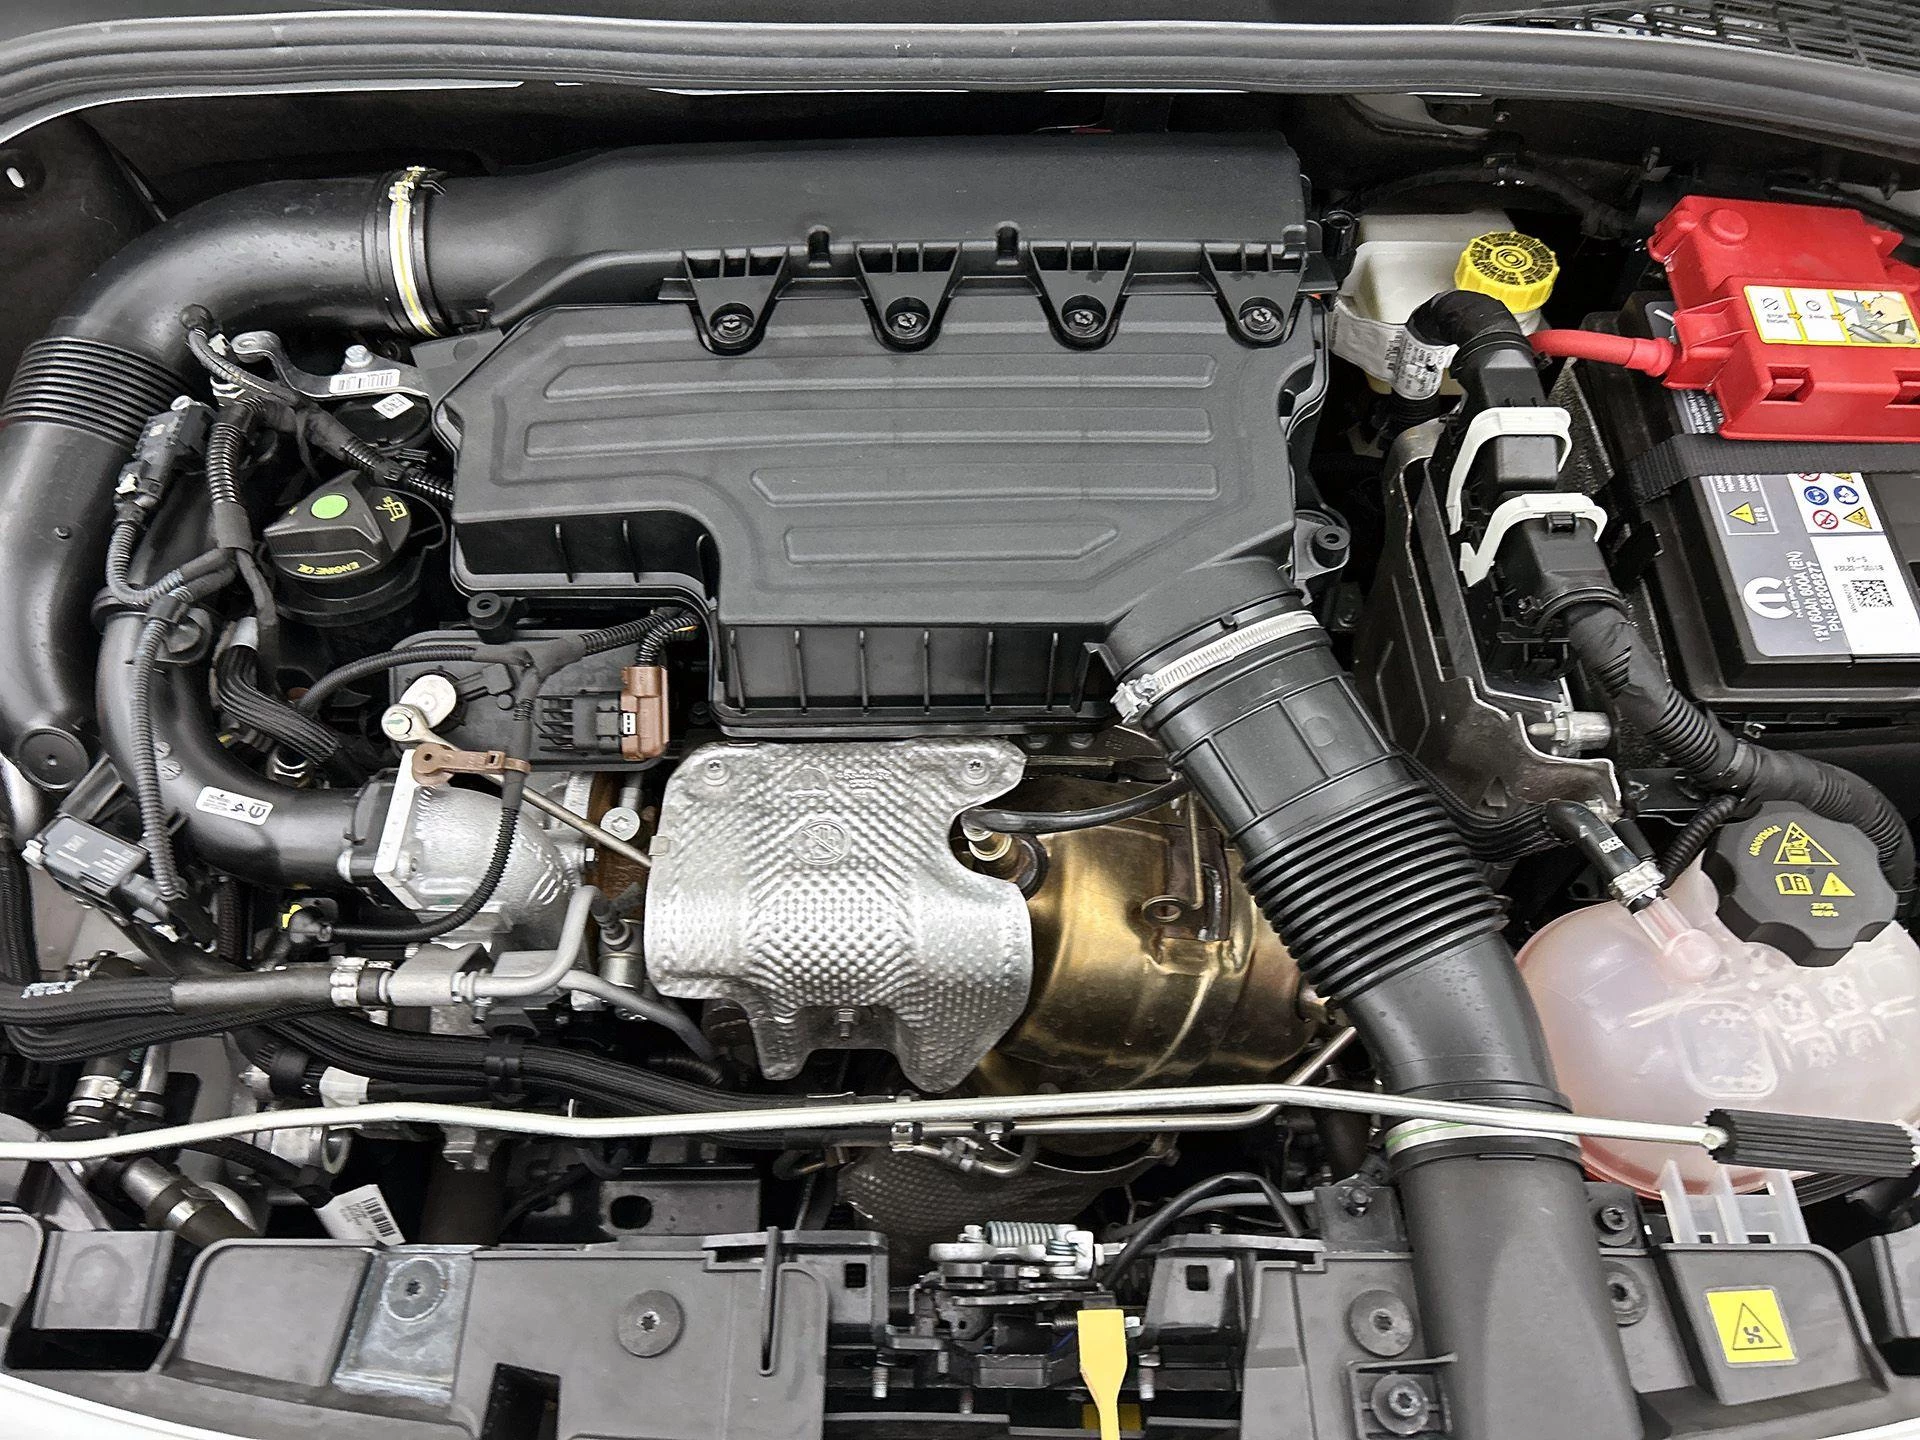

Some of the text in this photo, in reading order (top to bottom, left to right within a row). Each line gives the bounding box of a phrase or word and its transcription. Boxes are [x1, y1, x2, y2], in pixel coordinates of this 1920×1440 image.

[314, 561, 360, 575] ENGINE
[1785, 550, 1831, 642] 12V 60Ah 600A (EN)
[1825, 612, 1844, 632] PN:
